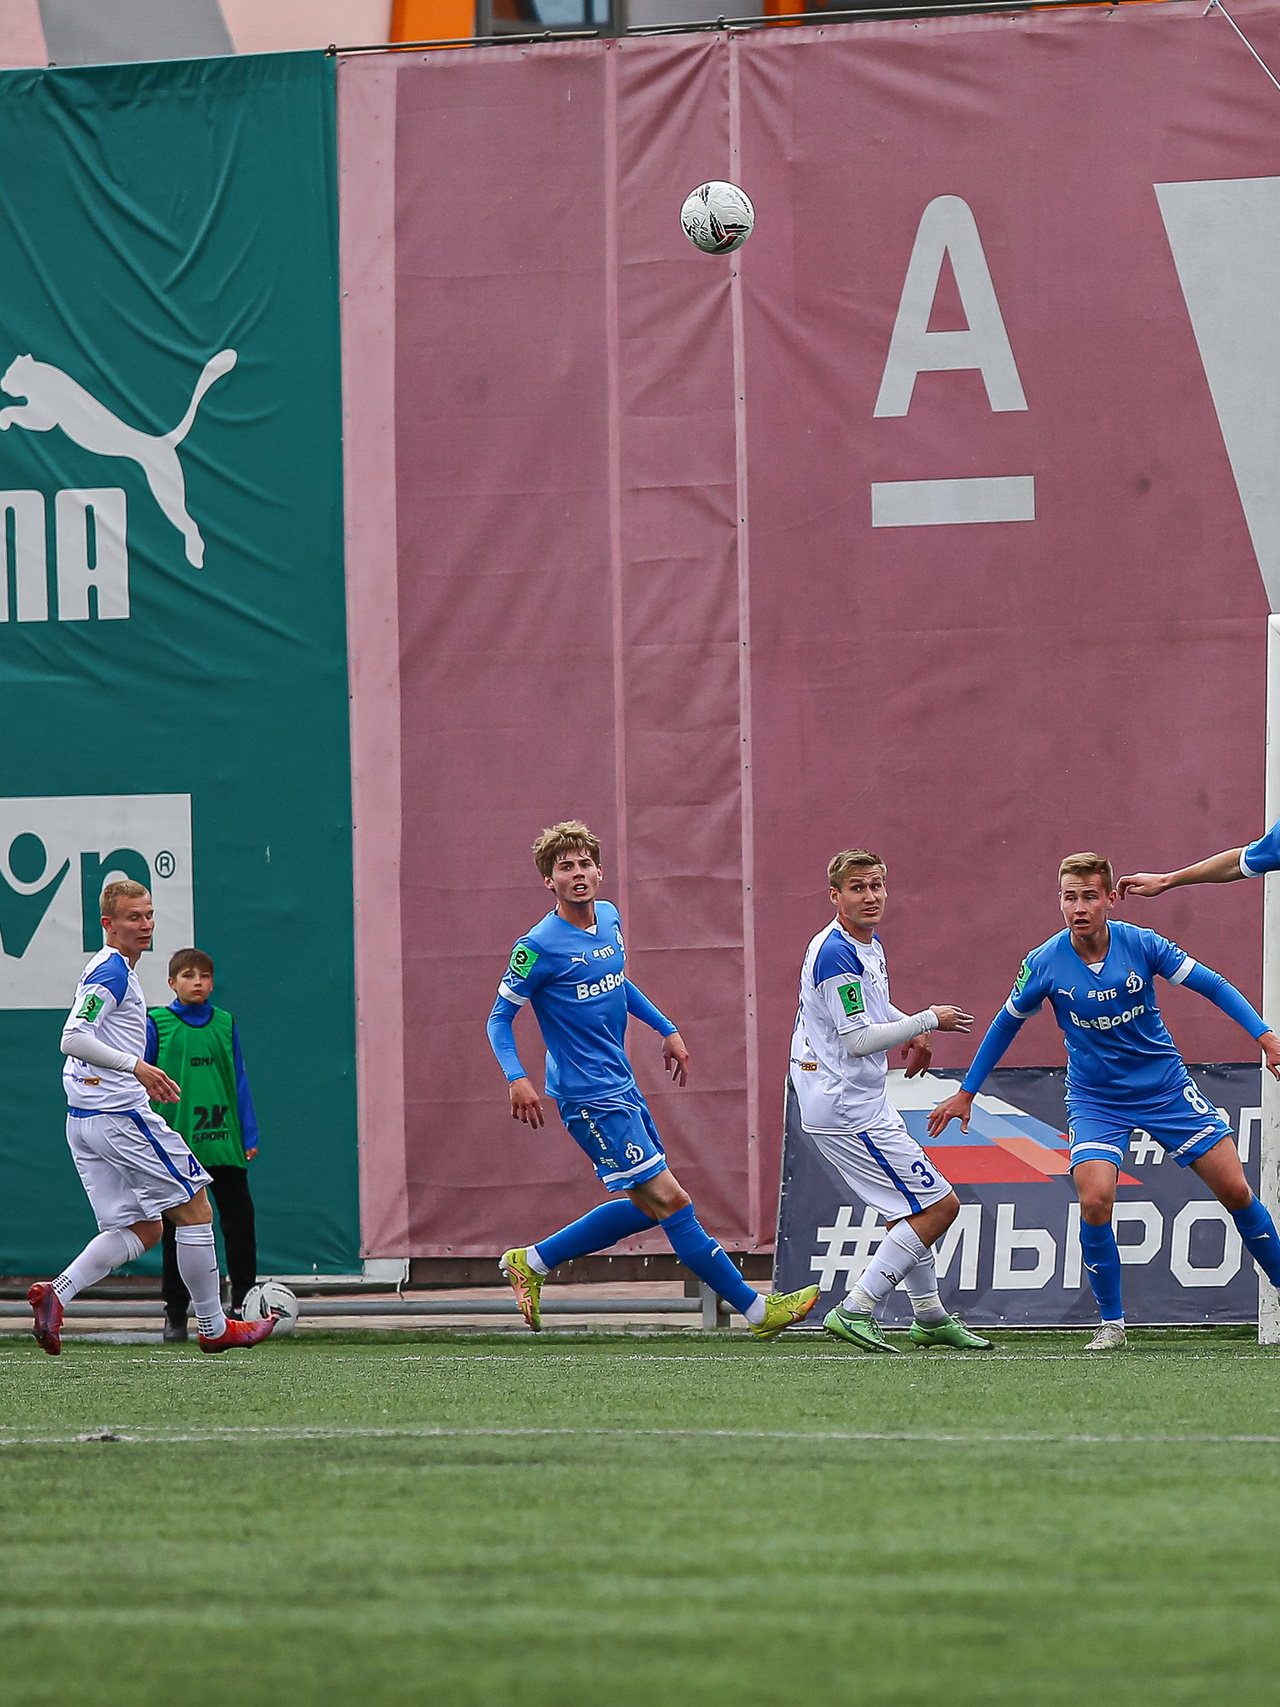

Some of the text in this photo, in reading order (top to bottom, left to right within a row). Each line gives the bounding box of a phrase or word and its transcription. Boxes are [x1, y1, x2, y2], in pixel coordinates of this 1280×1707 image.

[600, 944, 616, 959] ВТБ
[1097, 987, 1118, 1001] ВТБ
[1069, 1004, 1145, 1030] BetBoom
[193, 1105, 228, 1131] 2K
